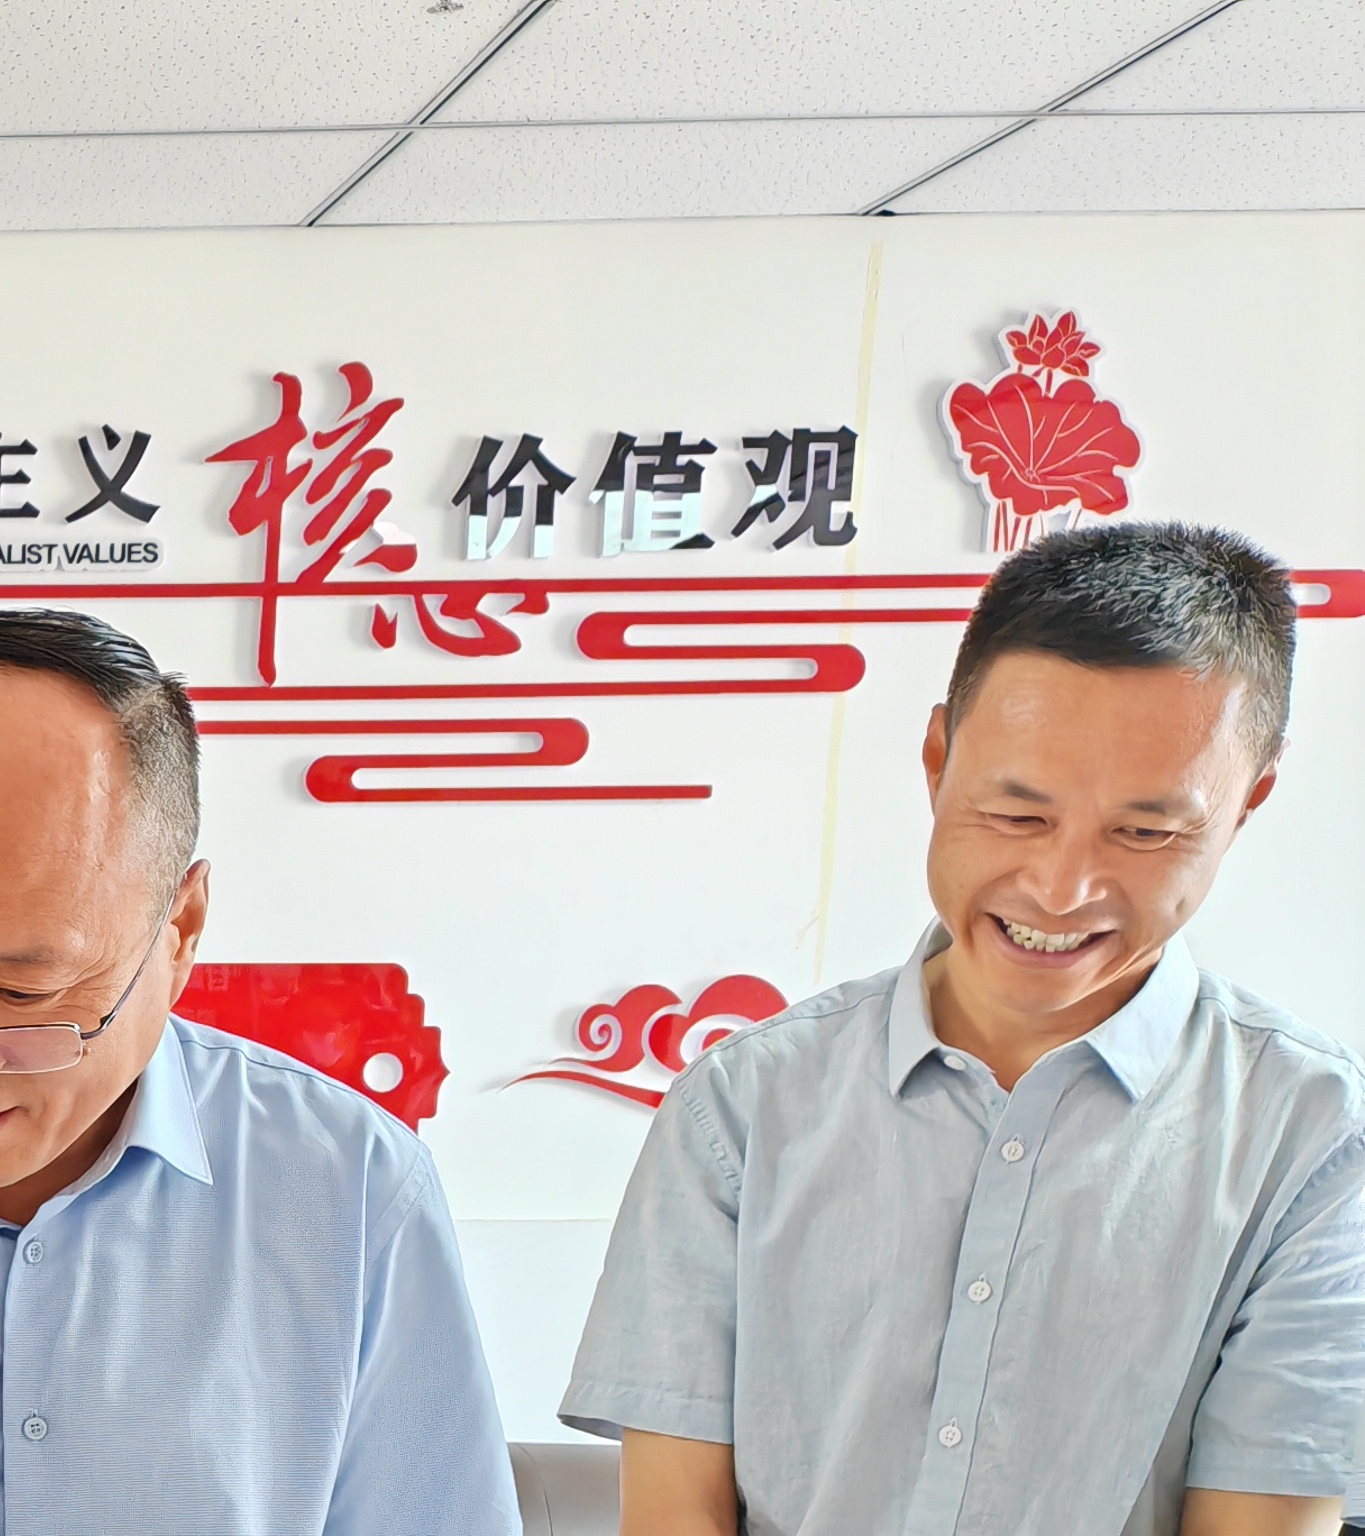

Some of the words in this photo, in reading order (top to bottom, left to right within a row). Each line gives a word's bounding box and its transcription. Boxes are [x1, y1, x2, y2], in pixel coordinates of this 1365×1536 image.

[452, 425, 859, 560] 价值观
[62, 542, 159, 565] VALUES
